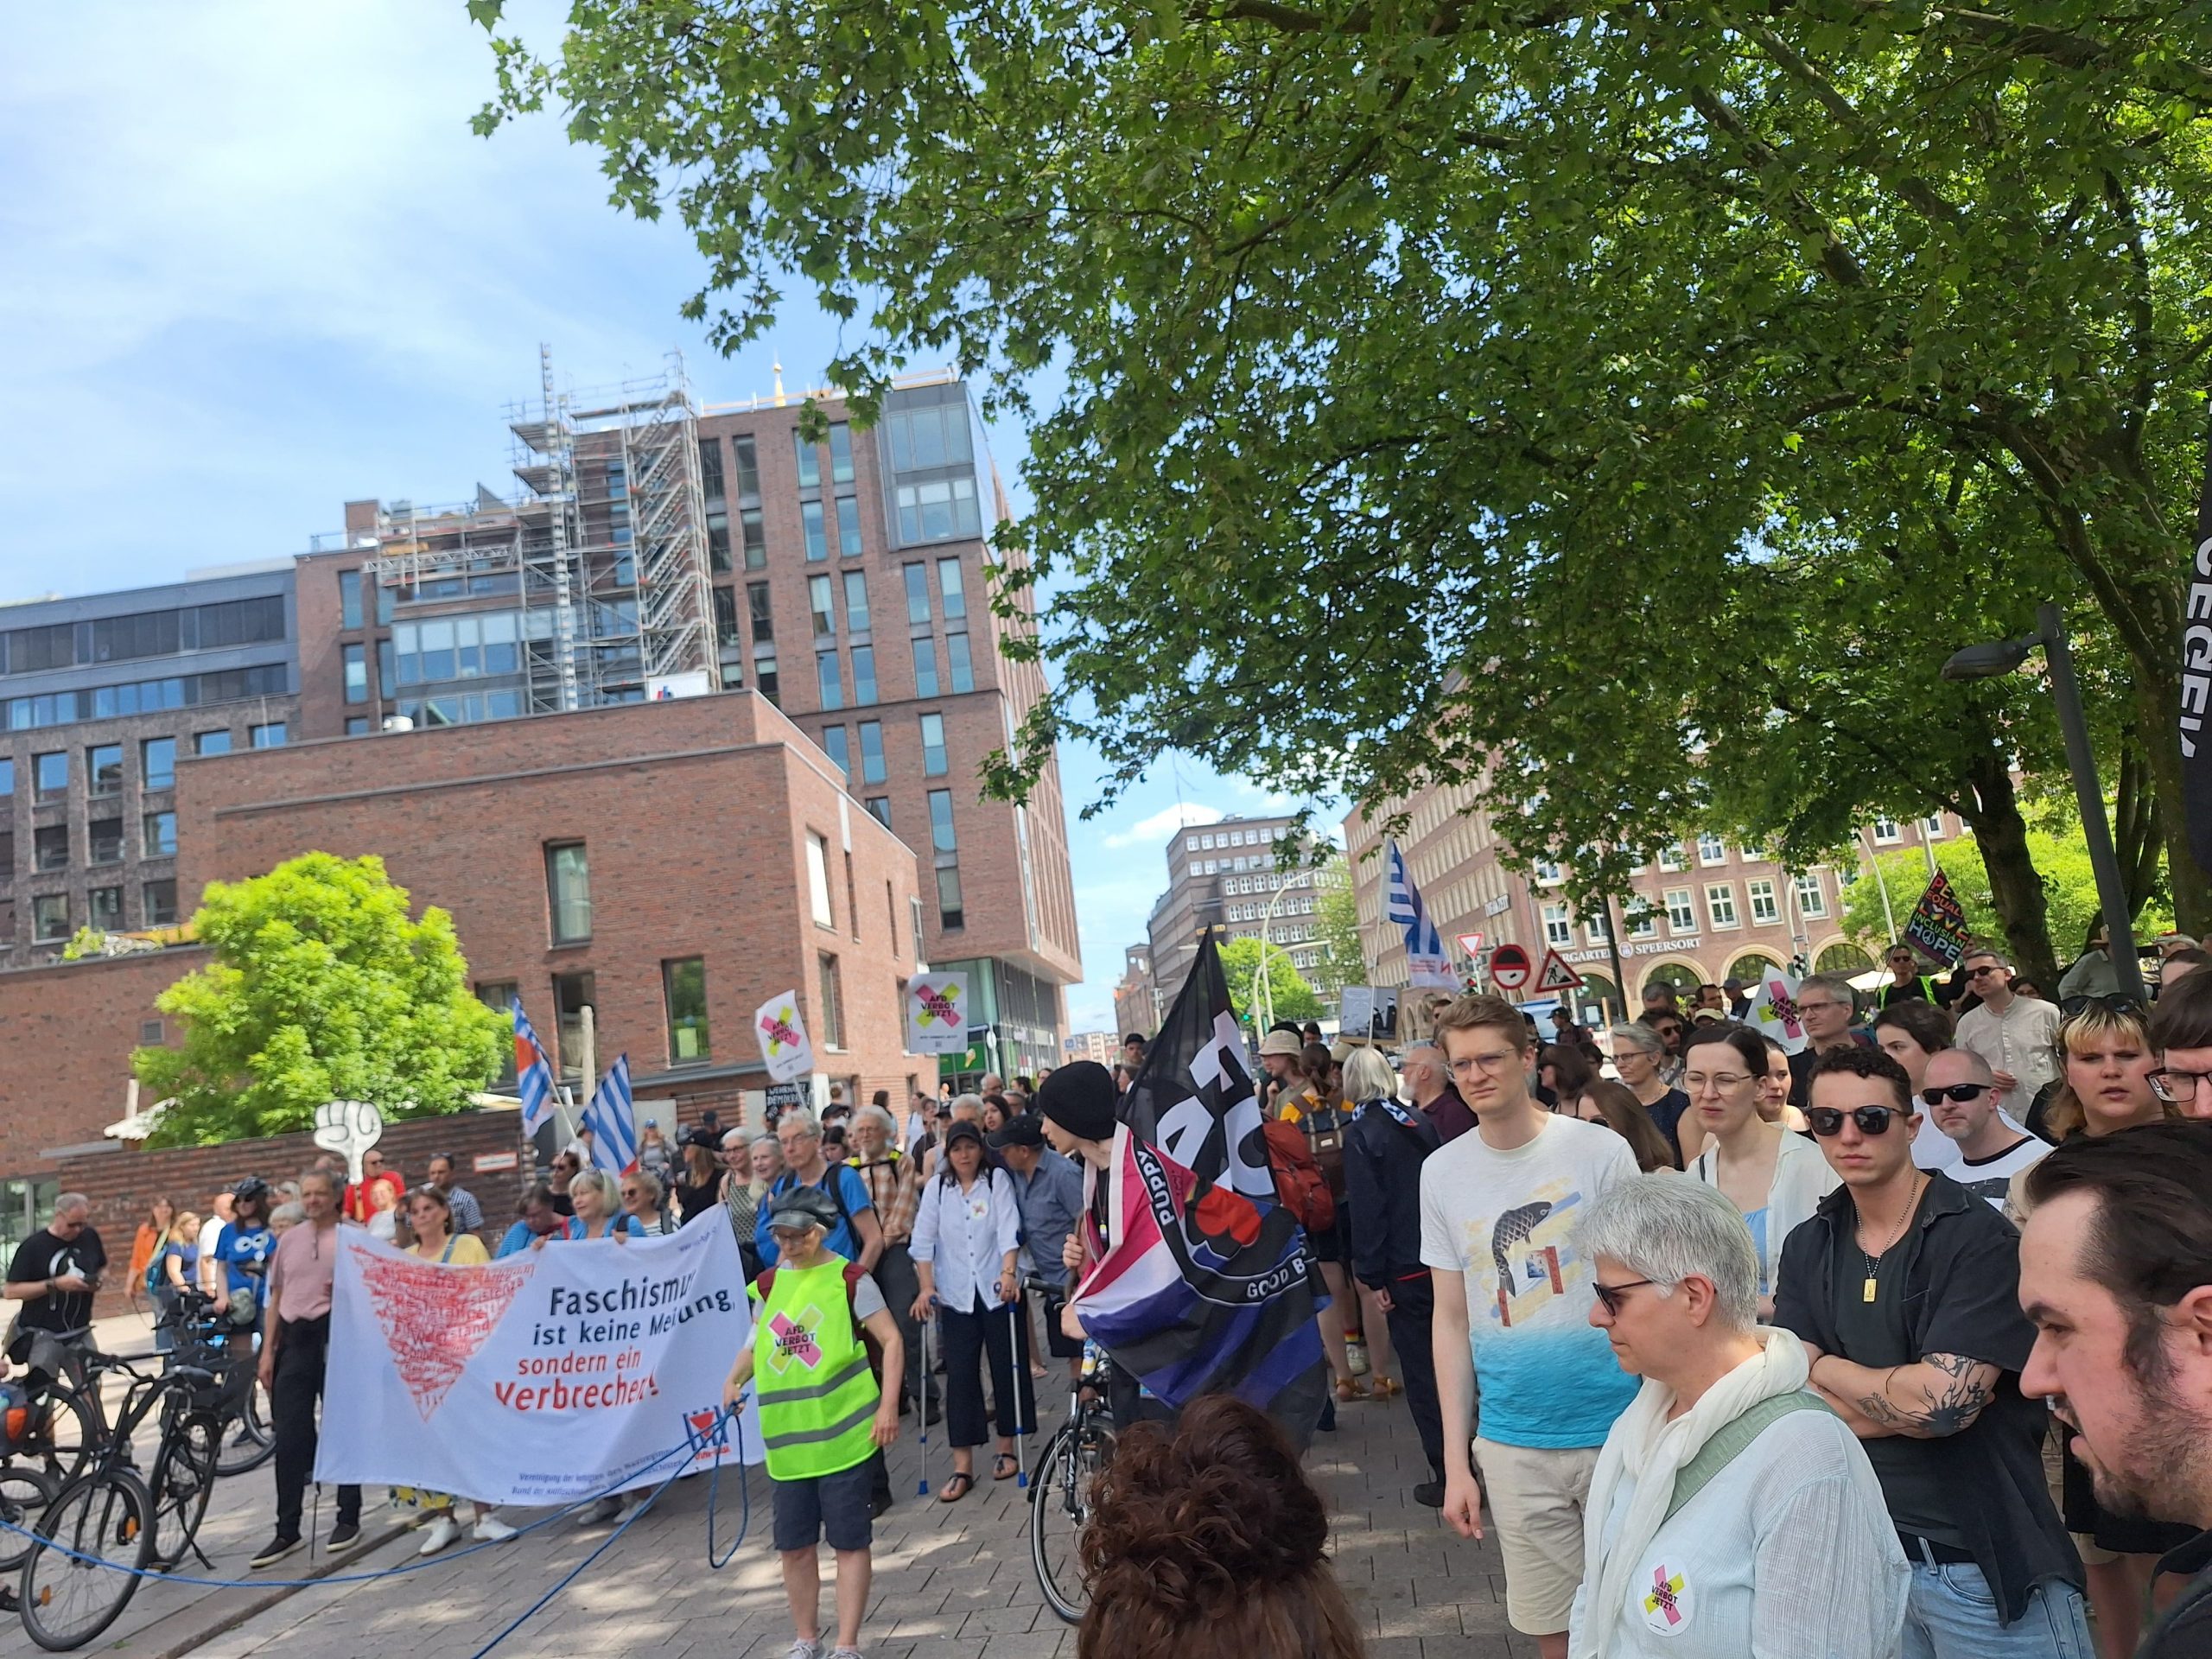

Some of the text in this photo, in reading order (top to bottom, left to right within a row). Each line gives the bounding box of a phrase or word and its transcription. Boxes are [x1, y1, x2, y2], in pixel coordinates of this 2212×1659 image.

[1635, 938, 1701, 955] SPEERSORT
[1136, 1150, 1175, 1226] PUPPY
[1246, 1268, 1289, 1299] GOOD
[550, 1269, 696, 1317] Faschismu
[533, 1323, 567, 1346] ist
[579, 1318, 641, 1344] keine
[785, 1325, 804, 1337] AFD
[774, 1332, 817, 1348] VERBOT
[781, 1344, 810, 1357] JETZT
[518, 1345, 642, 1376] sondern ein
[1652, 1586, 1678, 1604] VERBOT
[1660, 1581, 1672, 1592] AFD
[1652, 1596, 1673, 1611] JETZT
